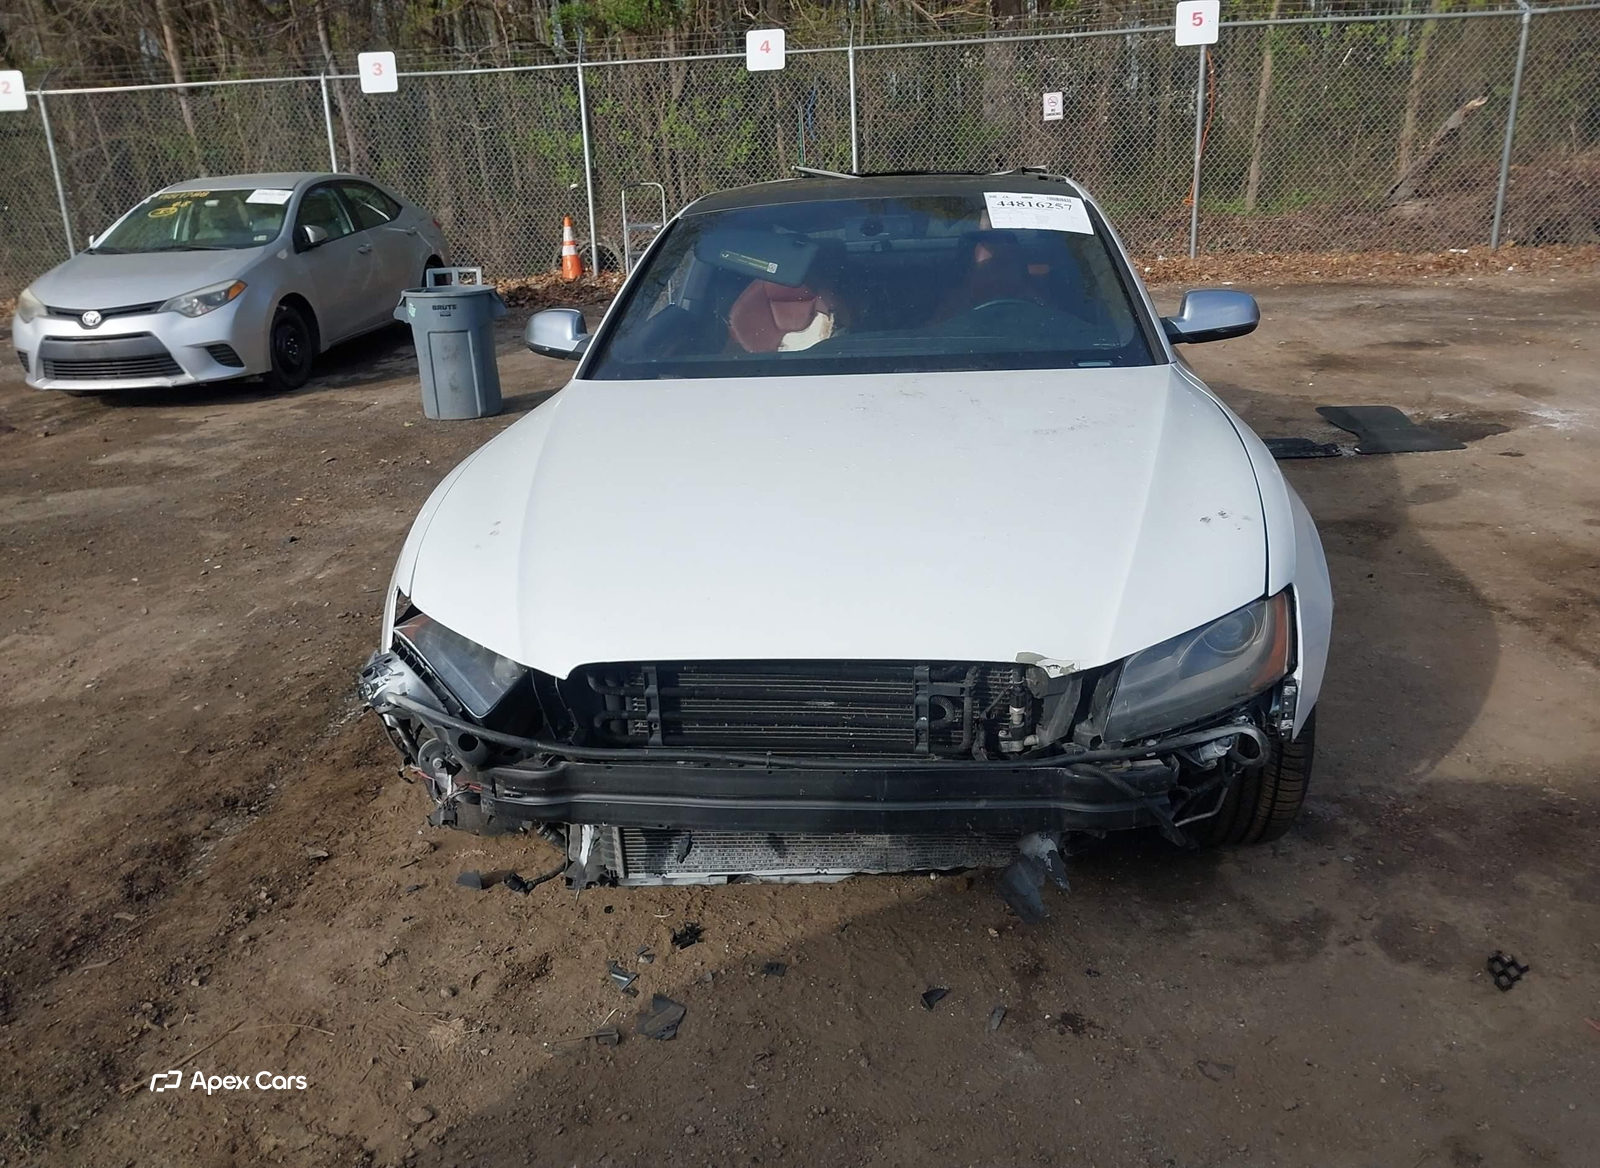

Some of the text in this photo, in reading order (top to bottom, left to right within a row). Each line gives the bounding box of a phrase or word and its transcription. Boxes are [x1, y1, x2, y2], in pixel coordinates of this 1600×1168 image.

[1192, 11, 1204, 27] 5
[760, 40, 771, 53] 4
[372, 62, 383, 76] 3
[1, 80, 12, 95] 2
[996, 200, 1072, 211] 44816257
